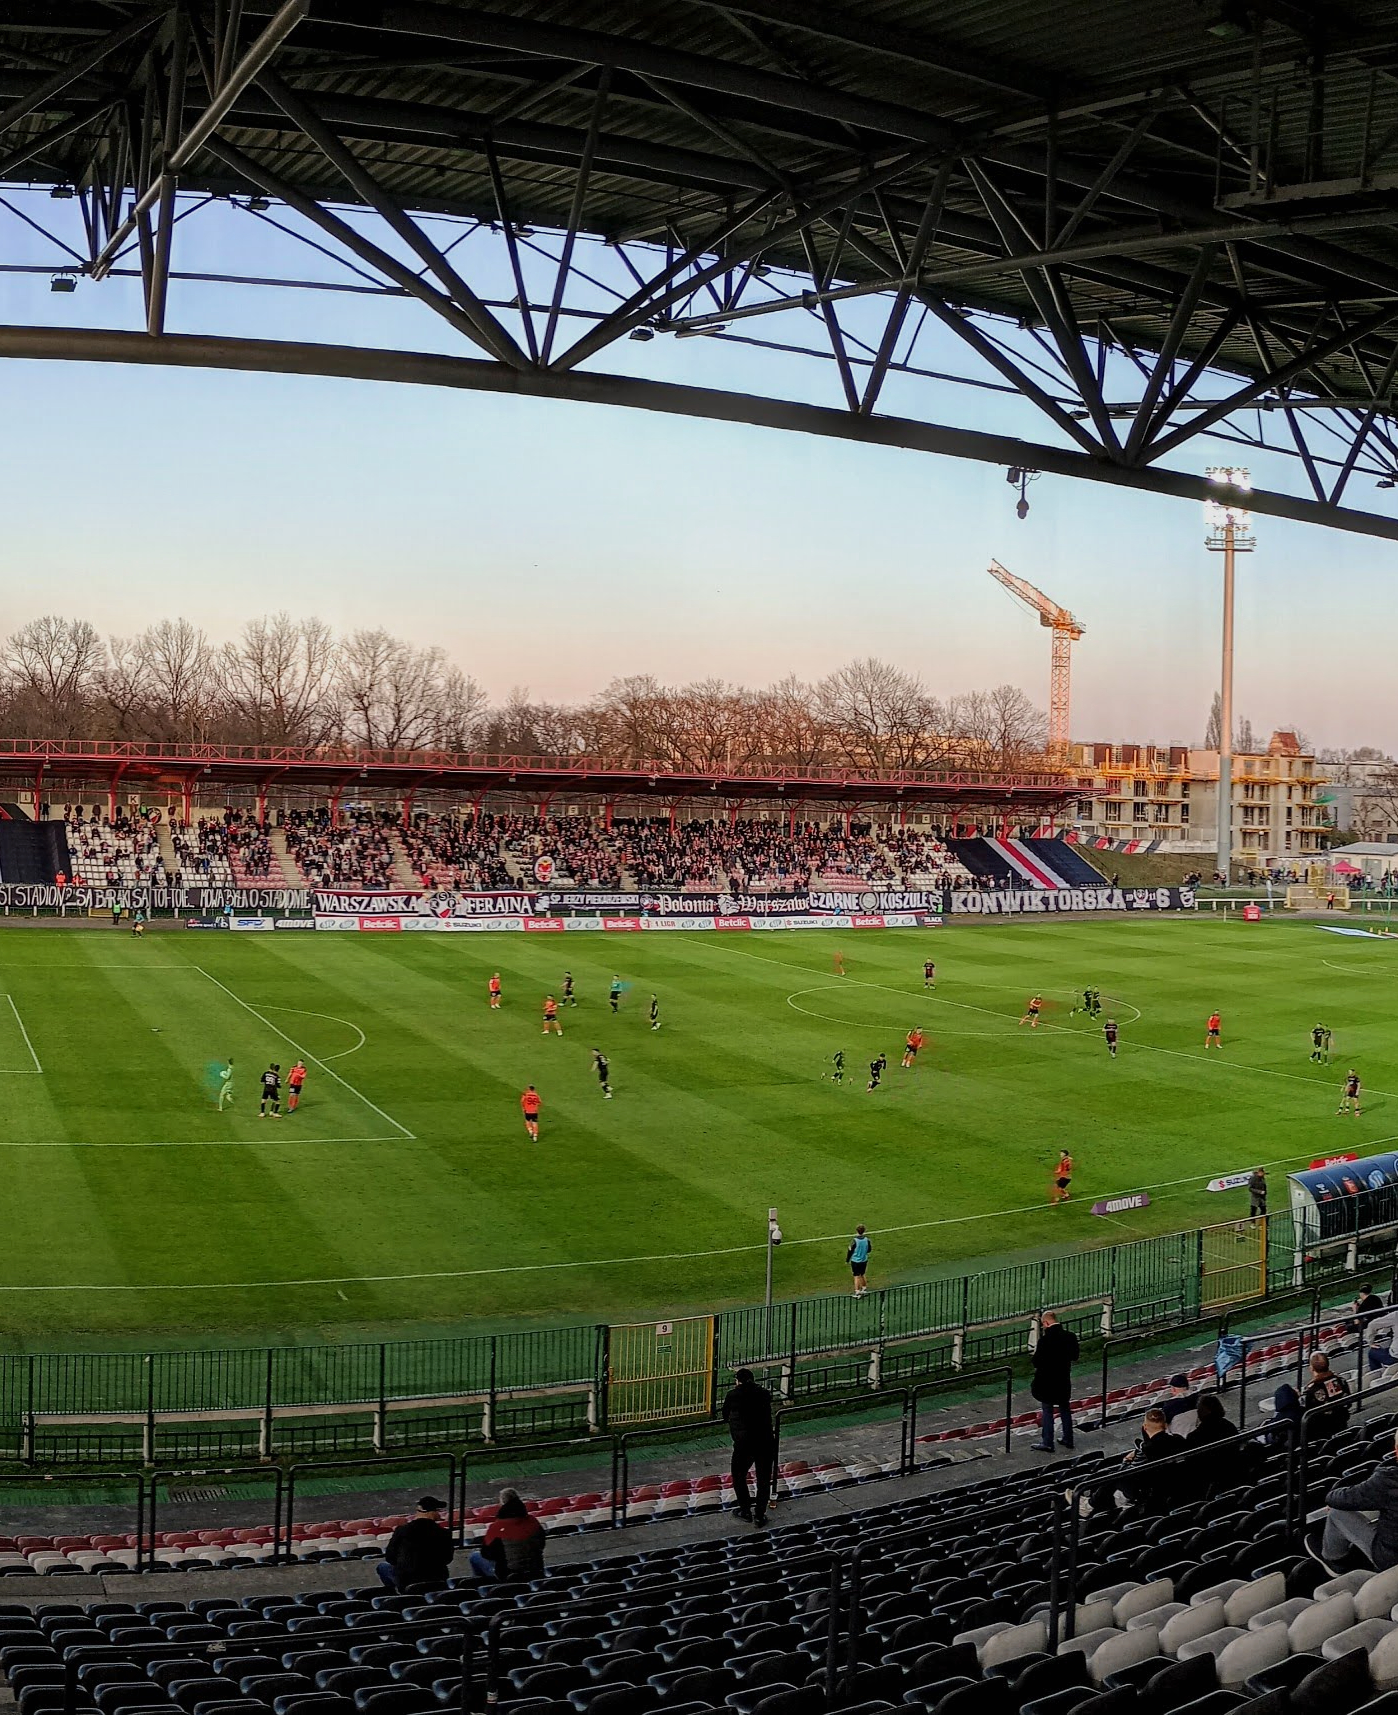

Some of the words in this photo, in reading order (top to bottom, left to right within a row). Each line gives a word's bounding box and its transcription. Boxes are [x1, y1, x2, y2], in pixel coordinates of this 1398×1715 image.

[315, 893, 419, 913] WARSZAWSKA
[467, 895, 534, 916] FERAJNA
[656, 894, 715, 915] Polonia
[809, 891, 859, 910] CZARNE
[879, 891, 928, 910] KOSZULE
[950, 888, 1127, 913] KONWIKTORSKA
[1156, 887, 1171, 908] 6
[362, 919, 399, 929] Betclic
[528, 920, 561, 929] Betclic
[606, 919, 637, 928] Betclic
[718, 918, 747, 927] Betclic
[855, 917, 882, 926] Betclic
[1106, 1194, 1143, 1214] 4MOVE
[661, 1324, 668, 1333] 9
